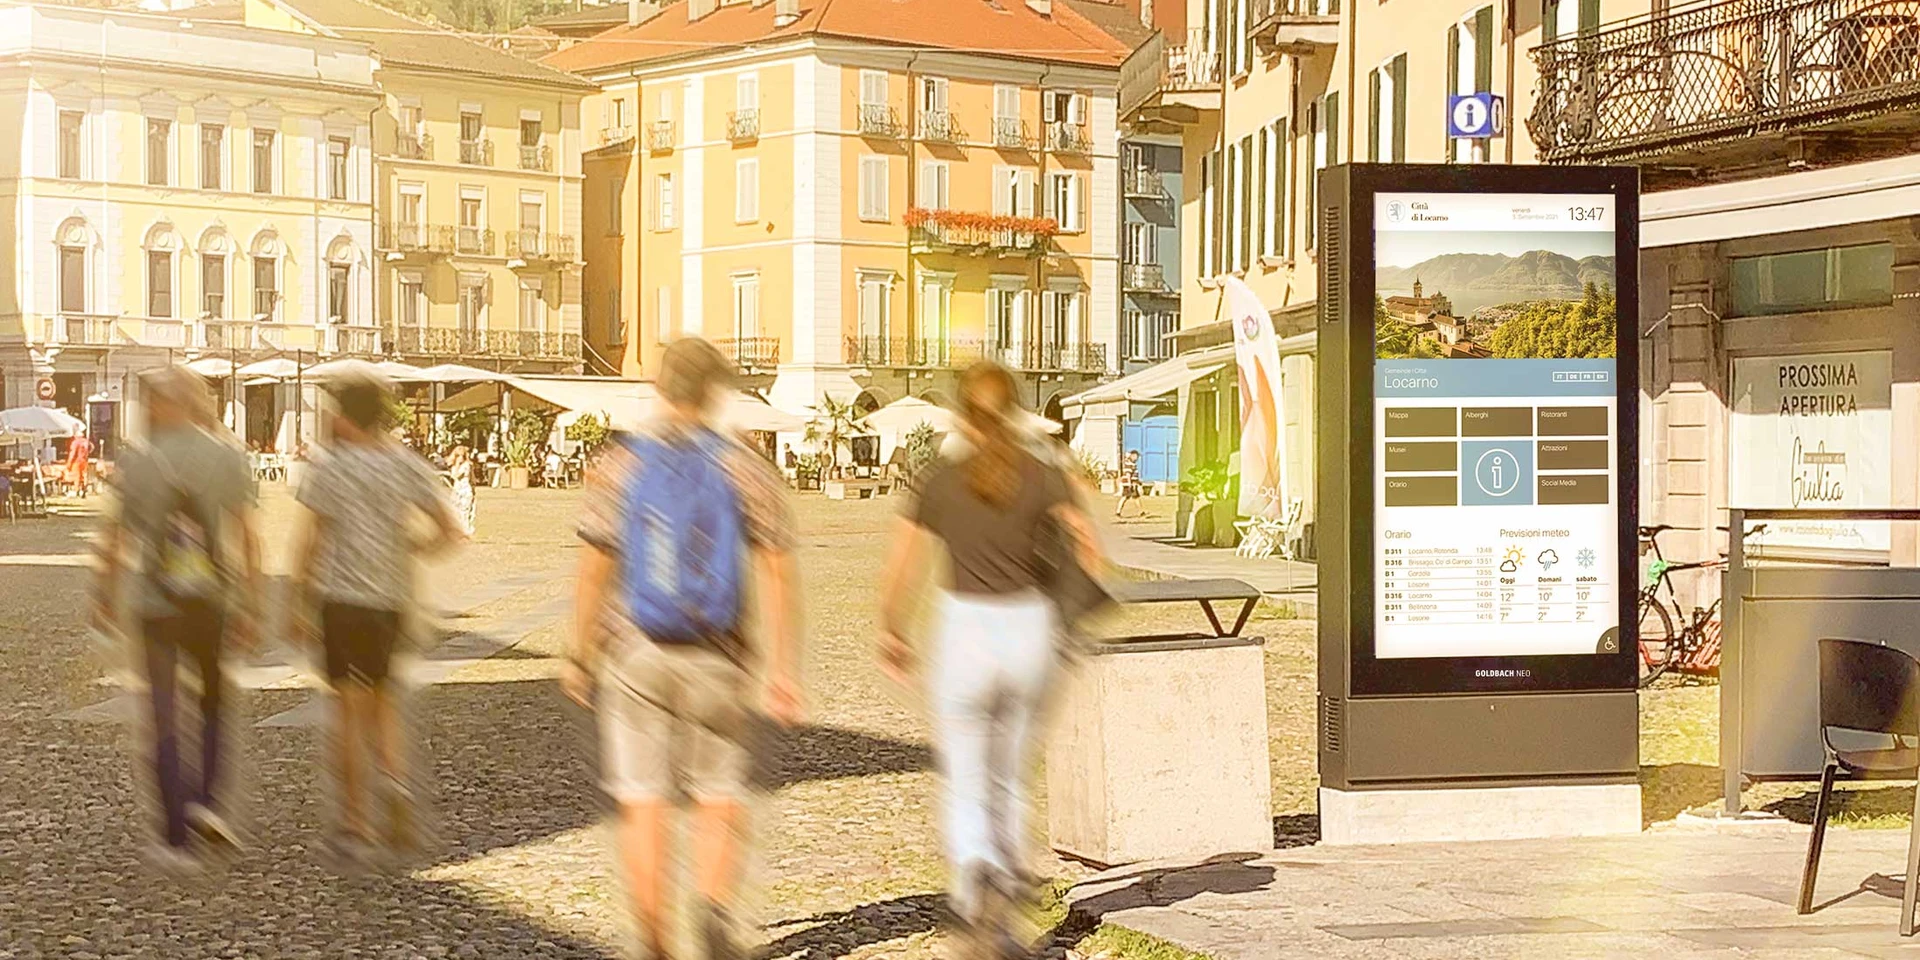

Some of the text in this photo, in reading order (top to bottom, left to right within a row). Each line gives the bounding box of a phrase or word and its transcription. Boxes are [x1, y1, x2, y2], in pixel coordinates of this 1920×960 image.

[1411, 202, 1429, 210] Città
[1411, 213, 1449, 222] di Locarno
[1568, 206, 1605, 221] 13:47
[1779, 363, 1858, 388] PROSSIMA
[1384, 376, 1438, 389] Locarno
[1780, 394, 1858, 417] APERTURA
[1465, 411, 1489, 419] Alberghi
[1791, 436, 1844, 508] Giulia
[1541, 479, 1577, 487] Social Media
[1384, 529, 1412, 539] Orario
[1499, 528, 1570, 538] Previsioni meteo
[1451, 558, 1473, 566] Campo
[1475, 669, 1531, 677] GOLDBACH NEO
